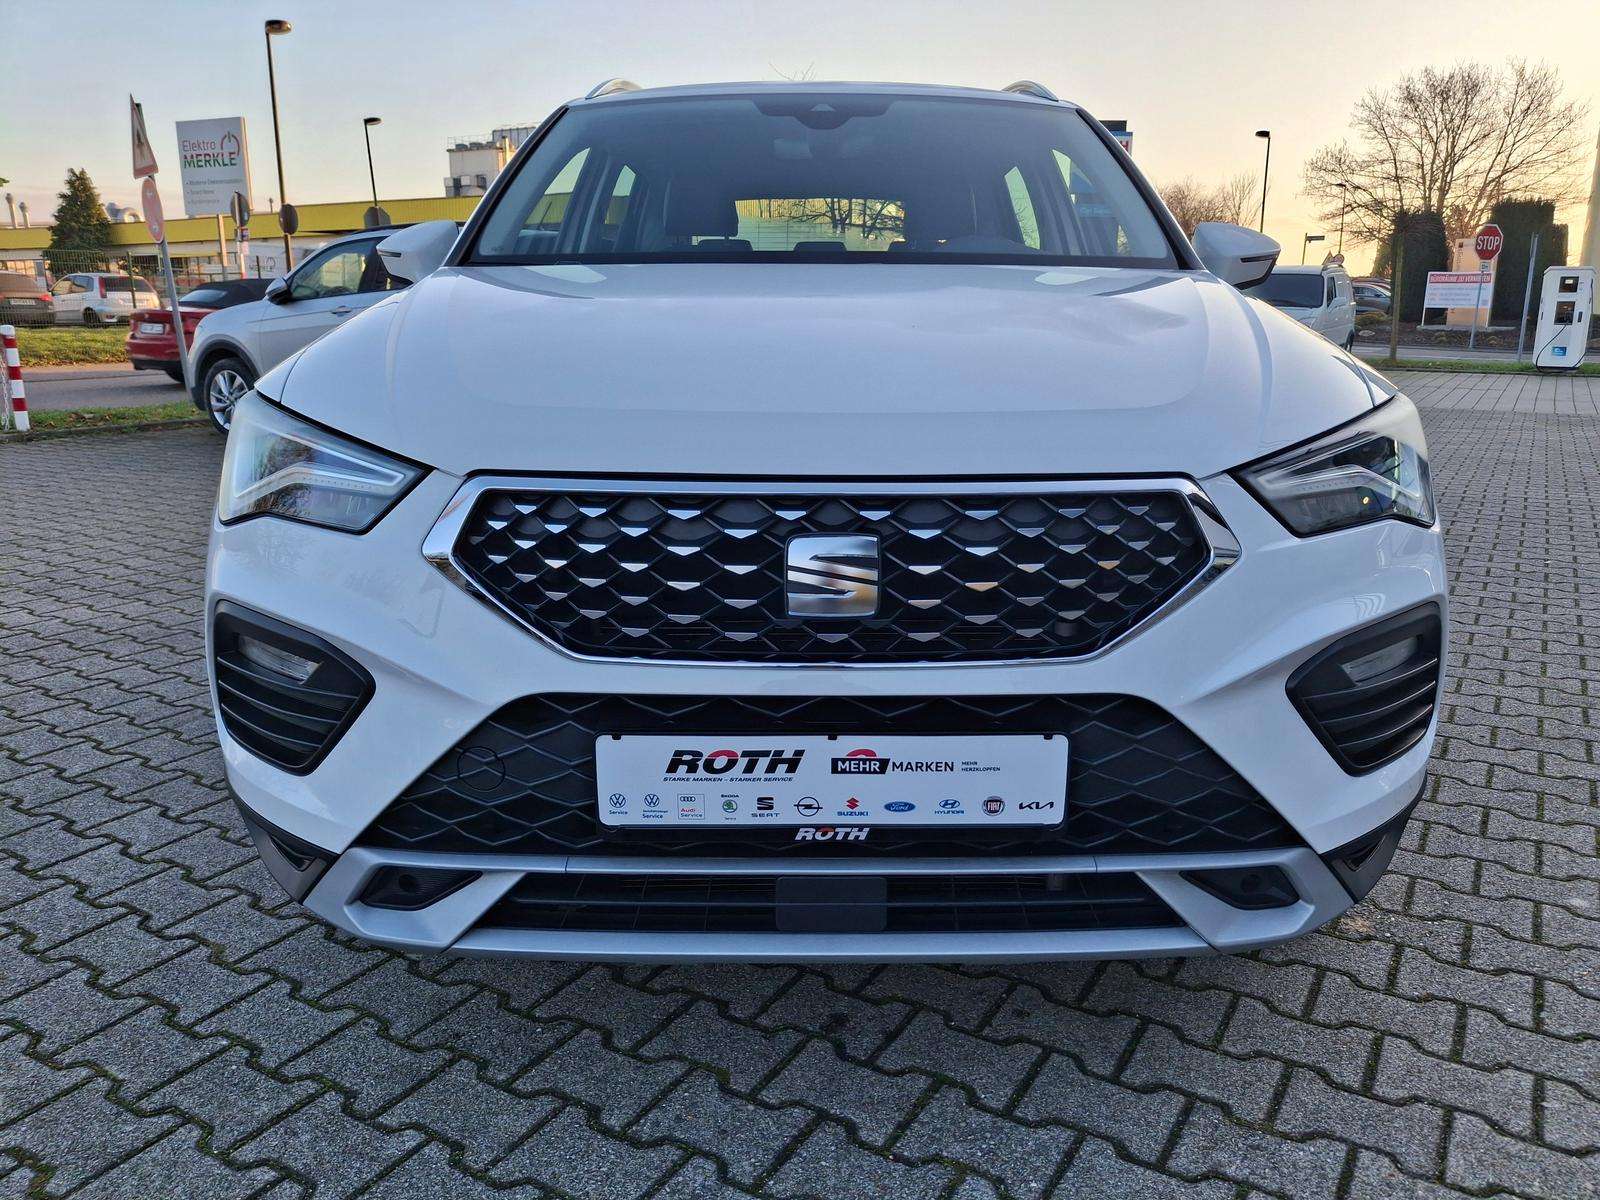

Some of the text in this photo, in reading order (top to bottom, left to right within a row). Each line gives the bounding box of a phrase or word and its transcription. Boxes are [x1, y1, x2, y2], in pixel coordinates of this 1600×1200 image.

[182, 139, 217, 152] Elektro
[183, 152, 237, 169] MERKLE
[1477, 236, 1500, 250] STOP
[665, 750, 805, 774] ROTH
[838, 761, 954, 772] MEHR MARKEN
[889, 801, 910, 811] Ford
[986, 802, 1001, 812] FIAT
[795, 827, 870, 841] ROTH
